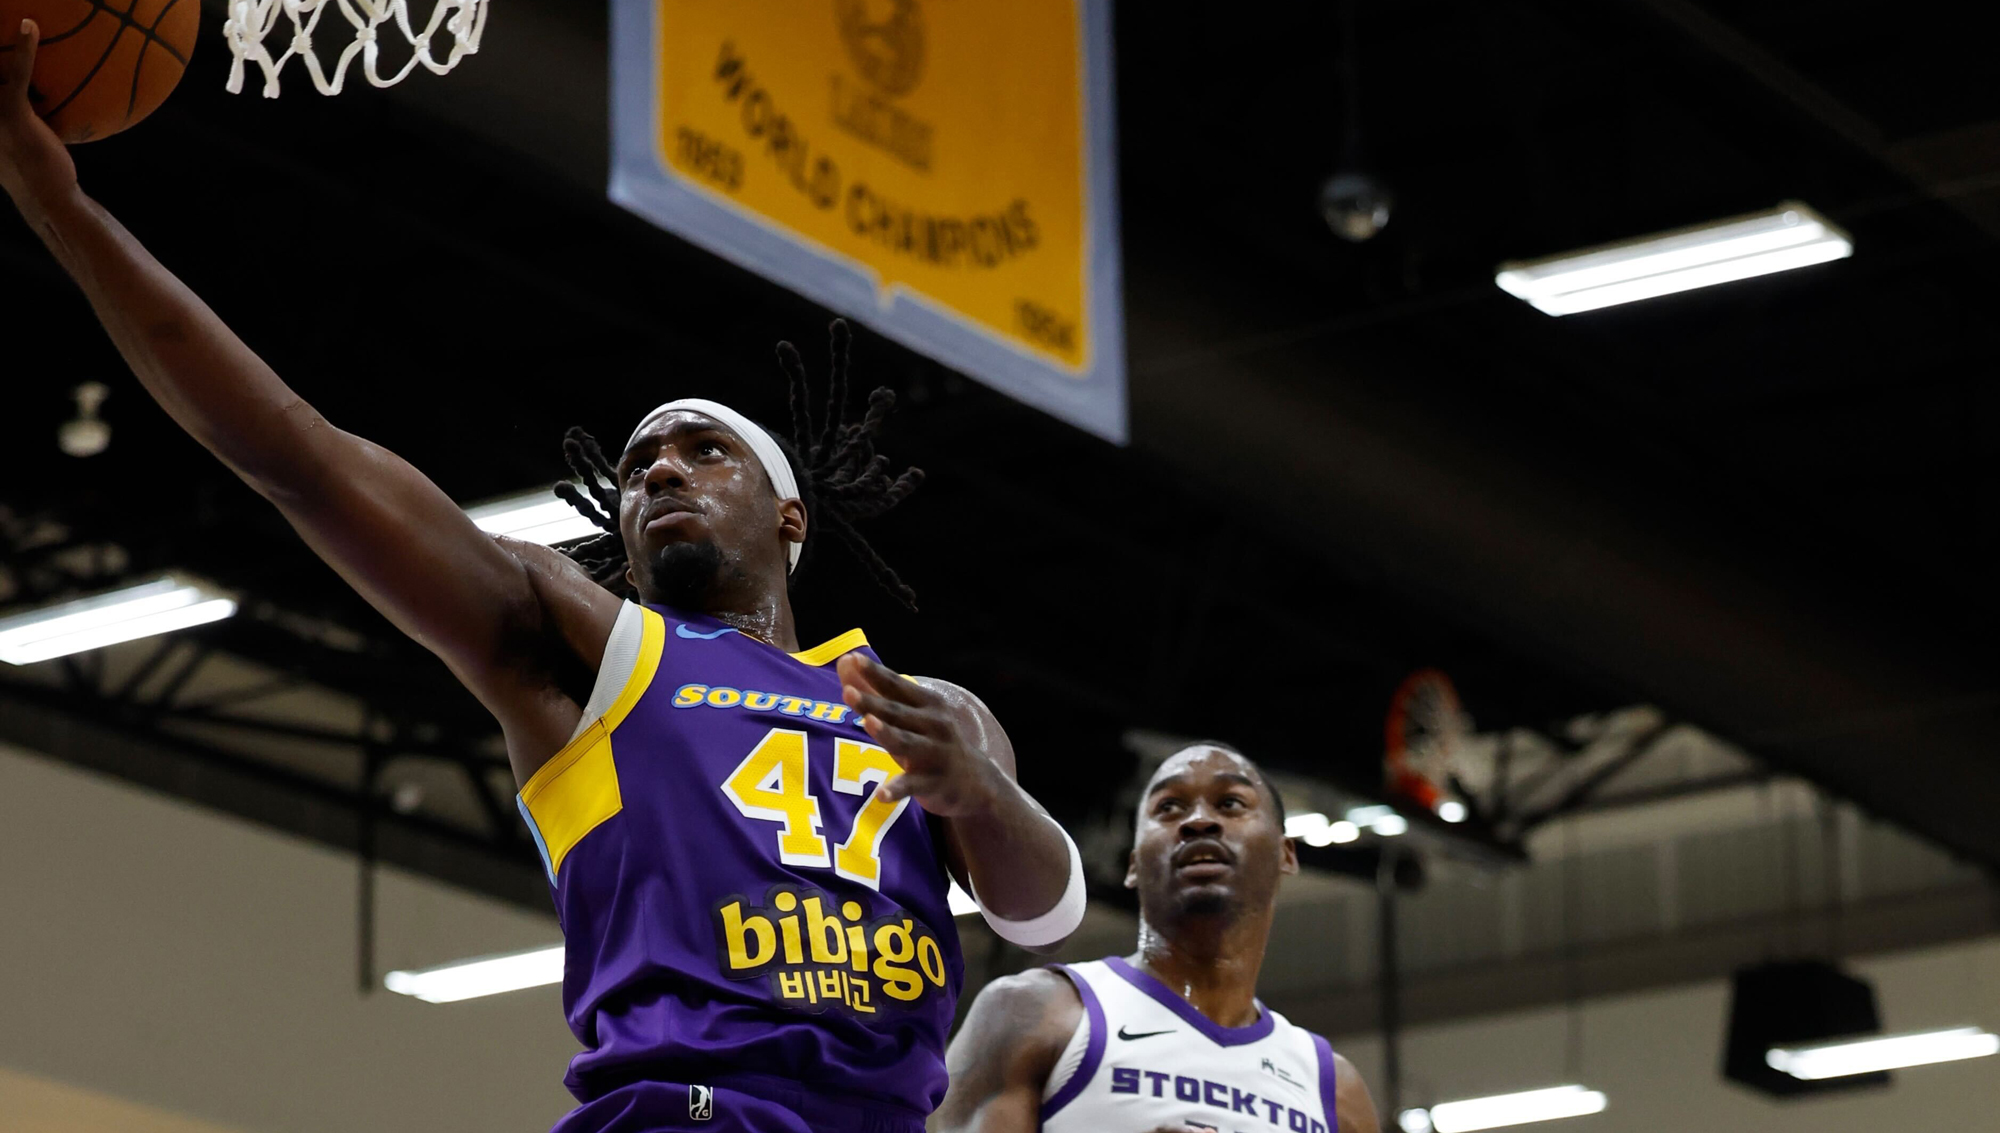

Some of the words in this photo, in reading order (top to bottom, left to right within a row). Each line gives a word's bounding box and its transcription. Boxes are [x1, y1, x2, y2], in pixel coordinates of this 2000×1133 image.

[713, 37, 842, 211] WORLD
[671, 684, 852, 724] SOUTH
[721, 728, 910, 891] 47
[719, 892, 945, 1000] bibigo
[778, 971, 876, 1013] 비비고
[702, 1109, 709, 1117] G
